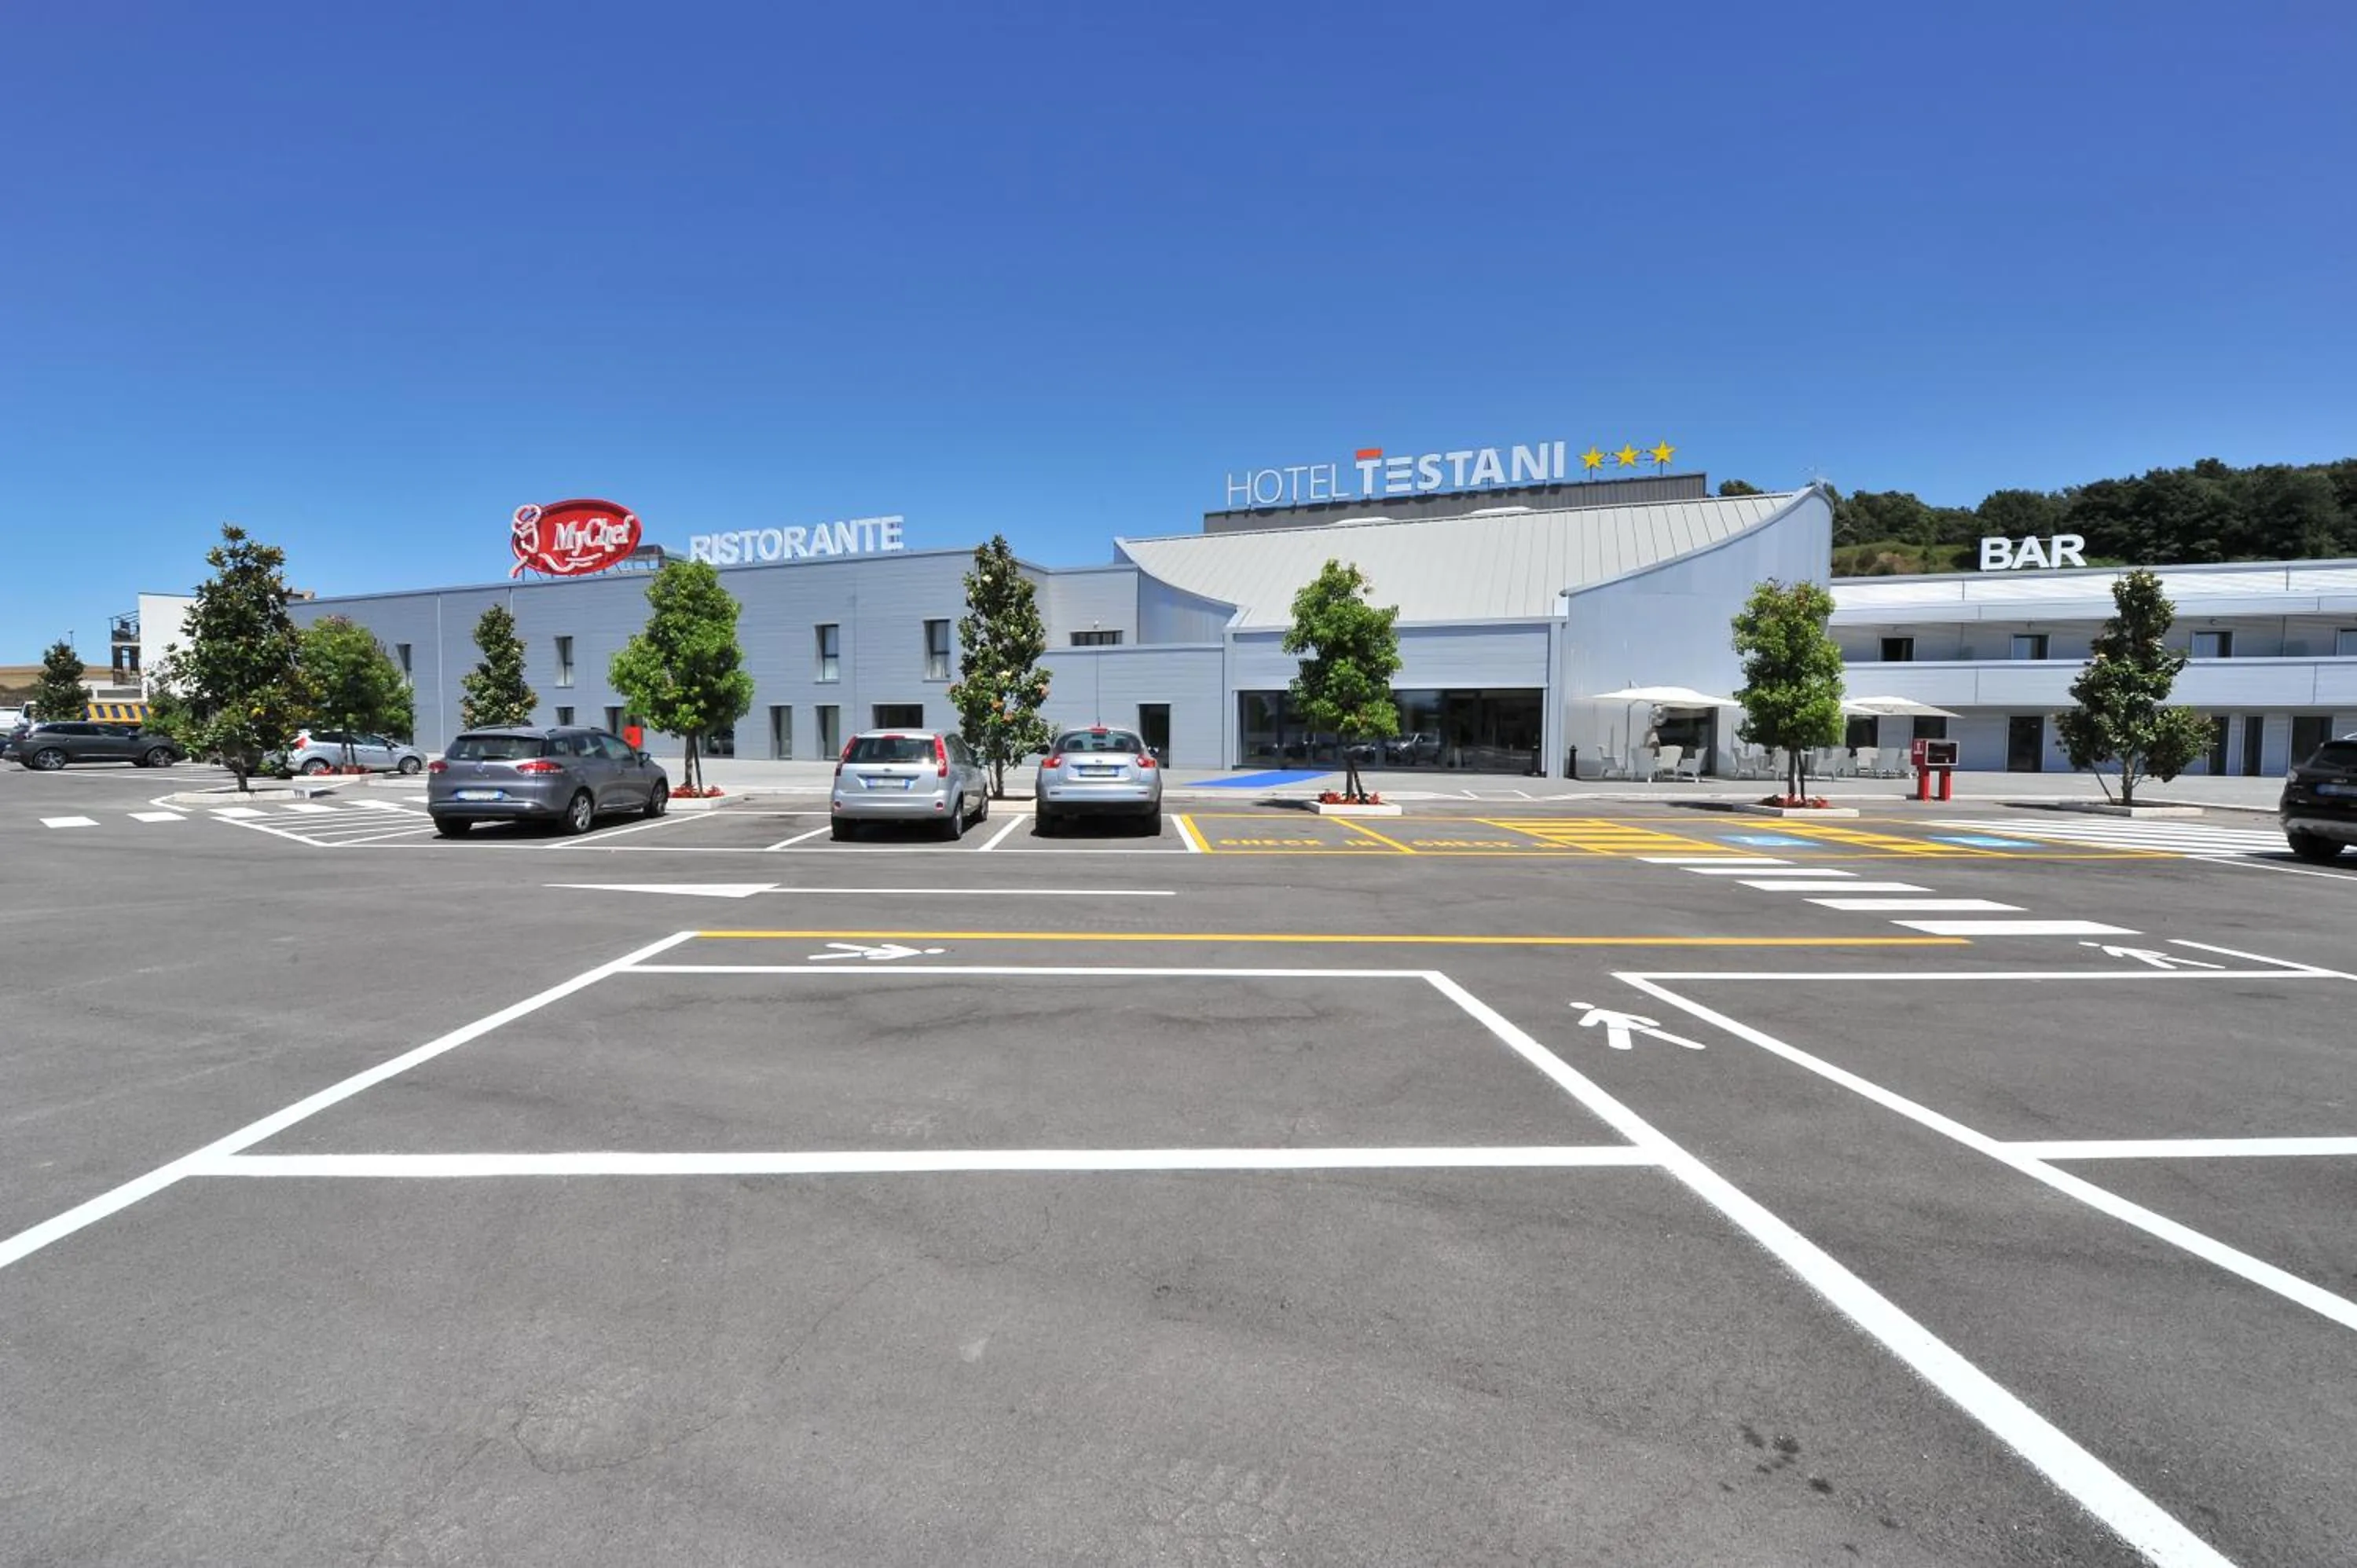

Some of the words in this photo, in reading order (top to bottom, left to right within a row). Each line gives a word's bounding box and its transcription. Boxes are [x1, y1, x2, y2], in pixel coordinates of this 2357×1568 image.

[1227, 463, 1349, 507] HOTEL
[1355, 441, 1565, 495] TESTANI
[552, 515, 633, 556] MyChef
[690, 515, 904, 564] RISTORANTE
[1981, 534, 2087, 570] BAR
[1219, 838, 1325, 847] CHECK
